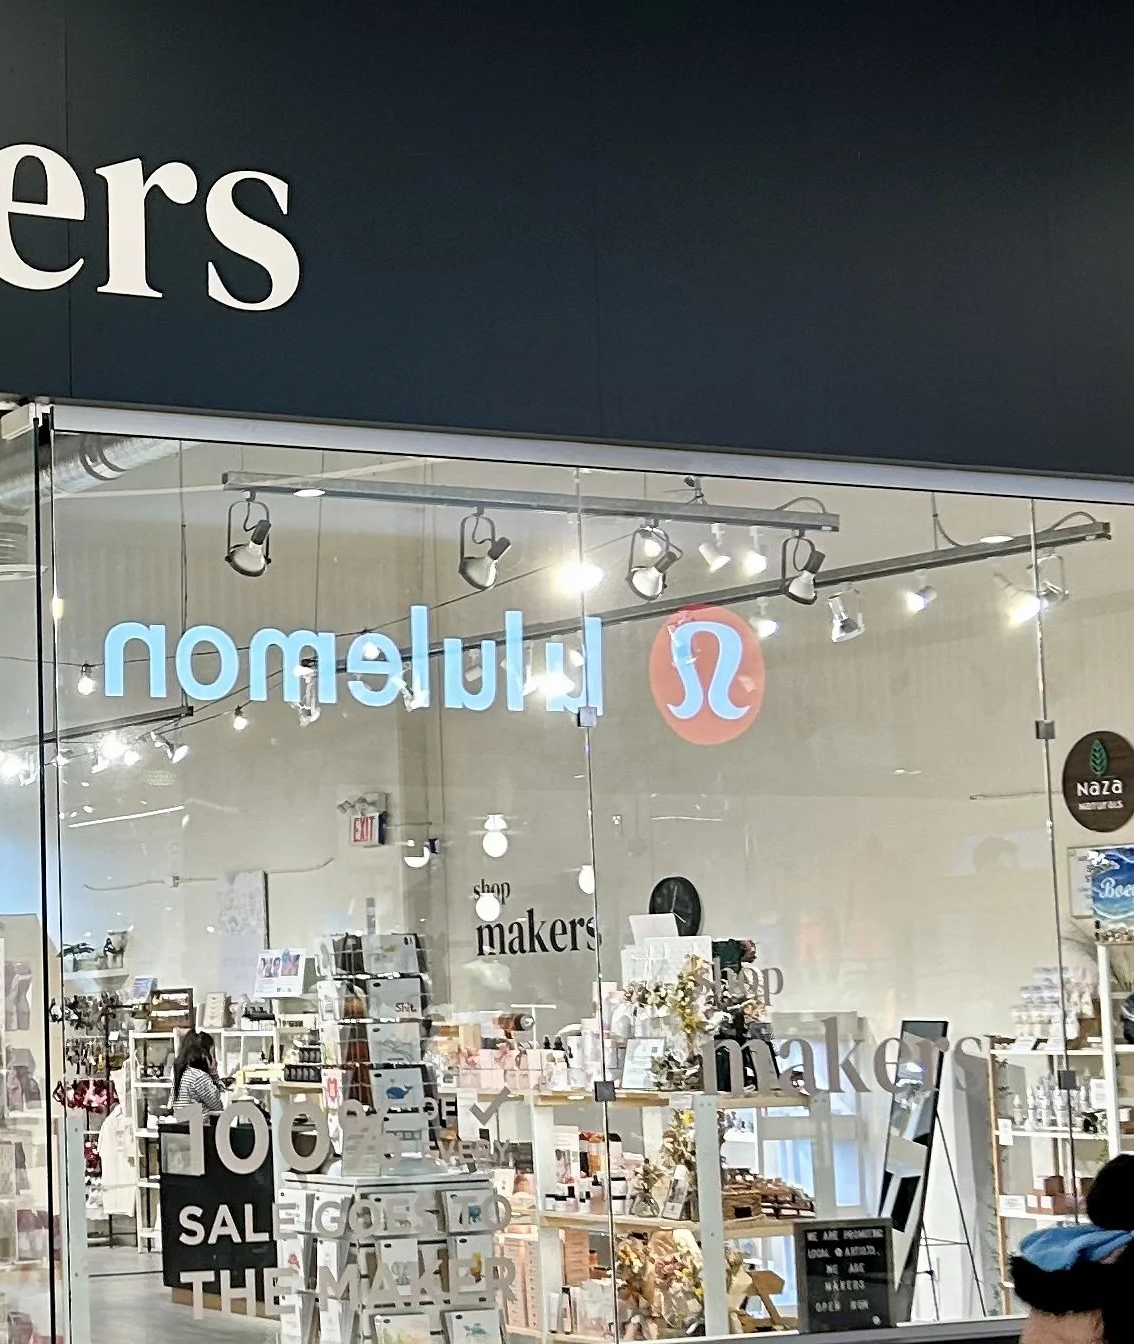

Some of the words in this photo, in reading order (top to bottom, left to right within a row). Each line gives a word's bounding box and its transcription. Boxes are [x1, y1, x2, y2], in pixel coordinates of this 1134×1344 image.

[354, 816, 375, 843] EXIT
[473, 878, 511, 905] shop
[476, 908, 603, 957] makers
[696, 956, 784, 1007] shop
[700, 1016, 988, 1095] makers
[177, 1098, 402, 1176] 100%
[419, 1095, 457, 1121] OF
[179, 1202, 299, 1247] SALE
[316, 1192, 436, 1239] GOES
[453, 1194, 513, 1233] TO
[180, 1266, 300, 1320] THE
[318, 1257, 517, 1313] MAKER
